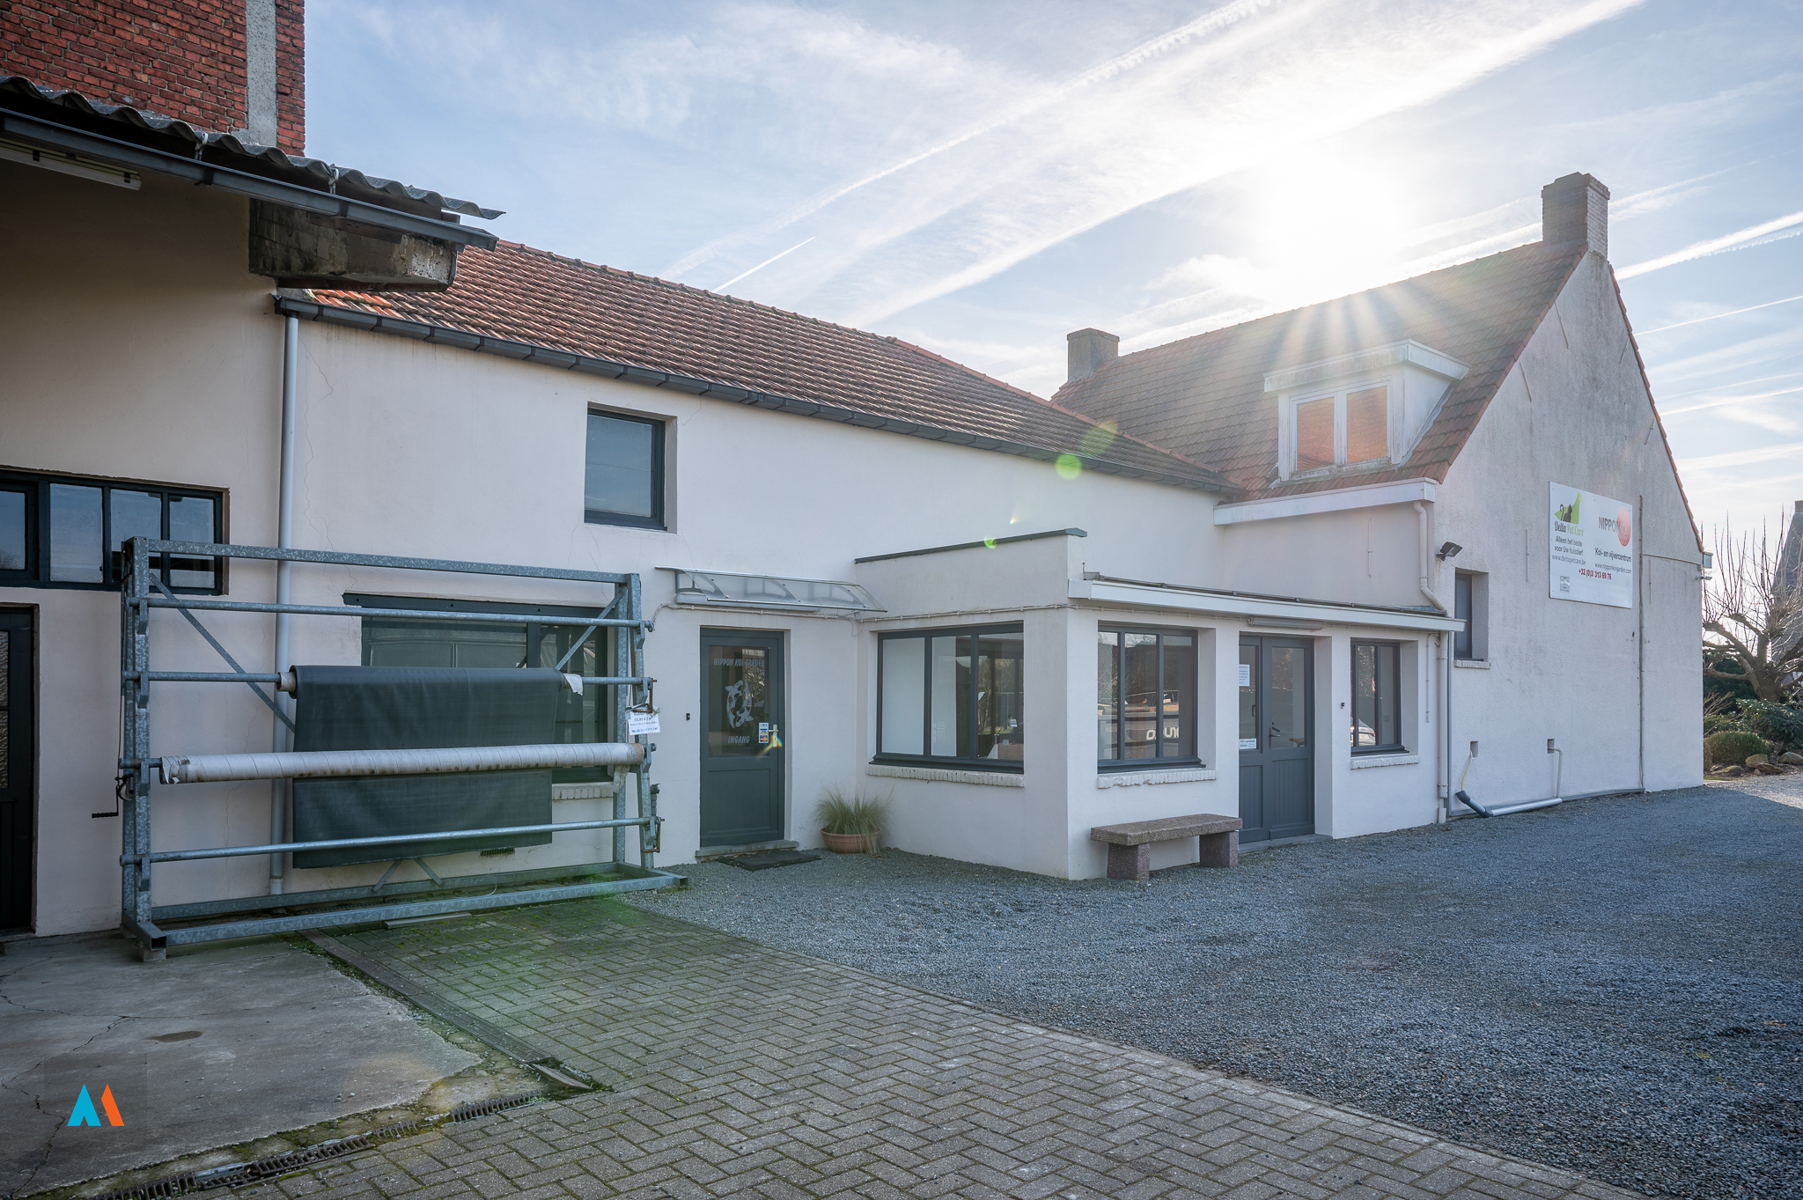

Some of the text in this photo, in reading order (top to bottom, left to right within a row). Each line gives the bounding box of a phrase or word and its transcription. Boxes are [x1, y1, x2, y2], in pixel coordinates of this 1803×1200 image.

[1555, 521, 1566, 532] Delta
[1575, 525, 1584, 536] Care
[1599, 516, 1620, 533] NIPPON
[1595, 548, 1603, 556] Koi-
[714, 658, 734, 666] NIPPON
[734, 658, 744, 666] KOI
[728, 736, 750, 744] INGANG
